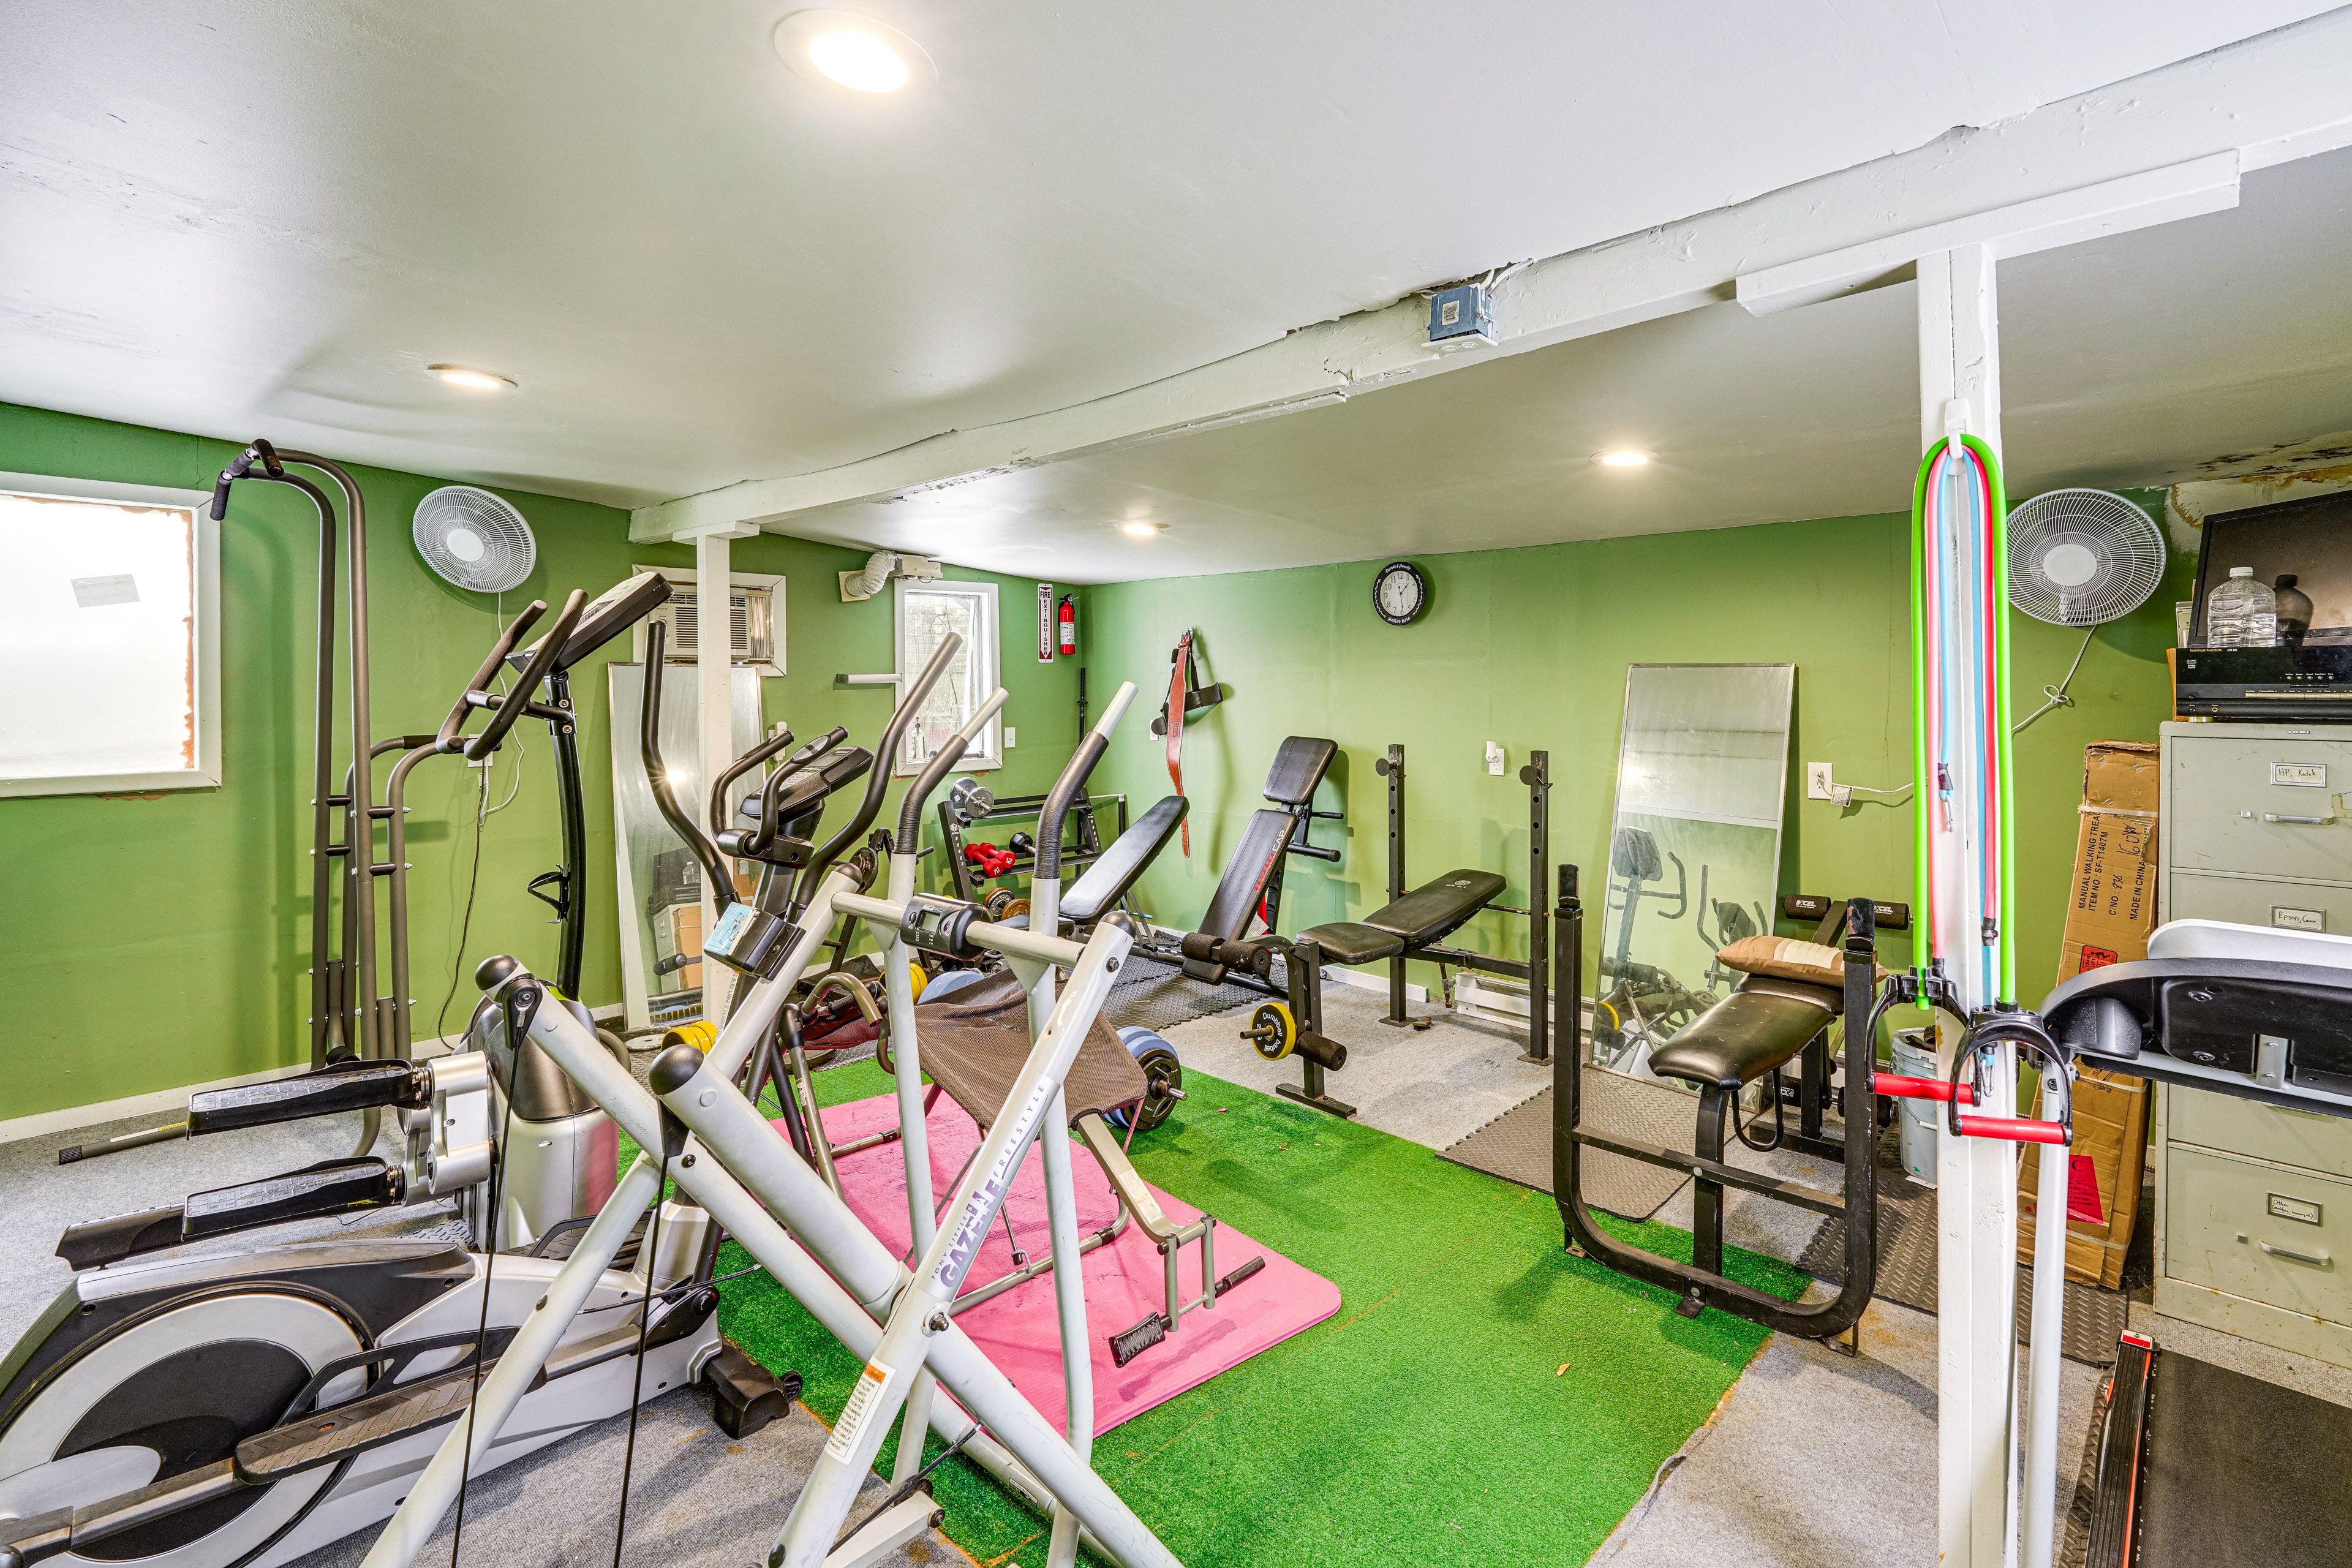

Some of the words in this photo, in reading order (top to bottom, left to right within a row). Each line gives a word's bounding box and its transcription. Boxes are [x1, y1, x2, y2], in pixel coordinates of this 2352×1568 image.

[1272, 830, 1285, 851] CAP
[2078, 874, 2090, 908] MANUAL
[2084, 838, 2096, 874] WALKING
[2089, 892, 2098, 911] ITEM
[2098, 831, 2108, 873] SF-T1407M
[2136, 861, 2146, 886] CHINA
[2134, 887, 2143, 897] IN
[2130, 897, 2141, 920] MADE
[1262, 1012, 1283, 1036] Dumbbell
[1264, 1039, 1281, 1052] barbell
[993, 1085, 1044, 1177] FREESTYLE
[932, 1252, 948, 1280] TONY
[949, 1204, 973, 1247] LITTLE'S
[940, 1178, 1004, 1287] GAZELLE
